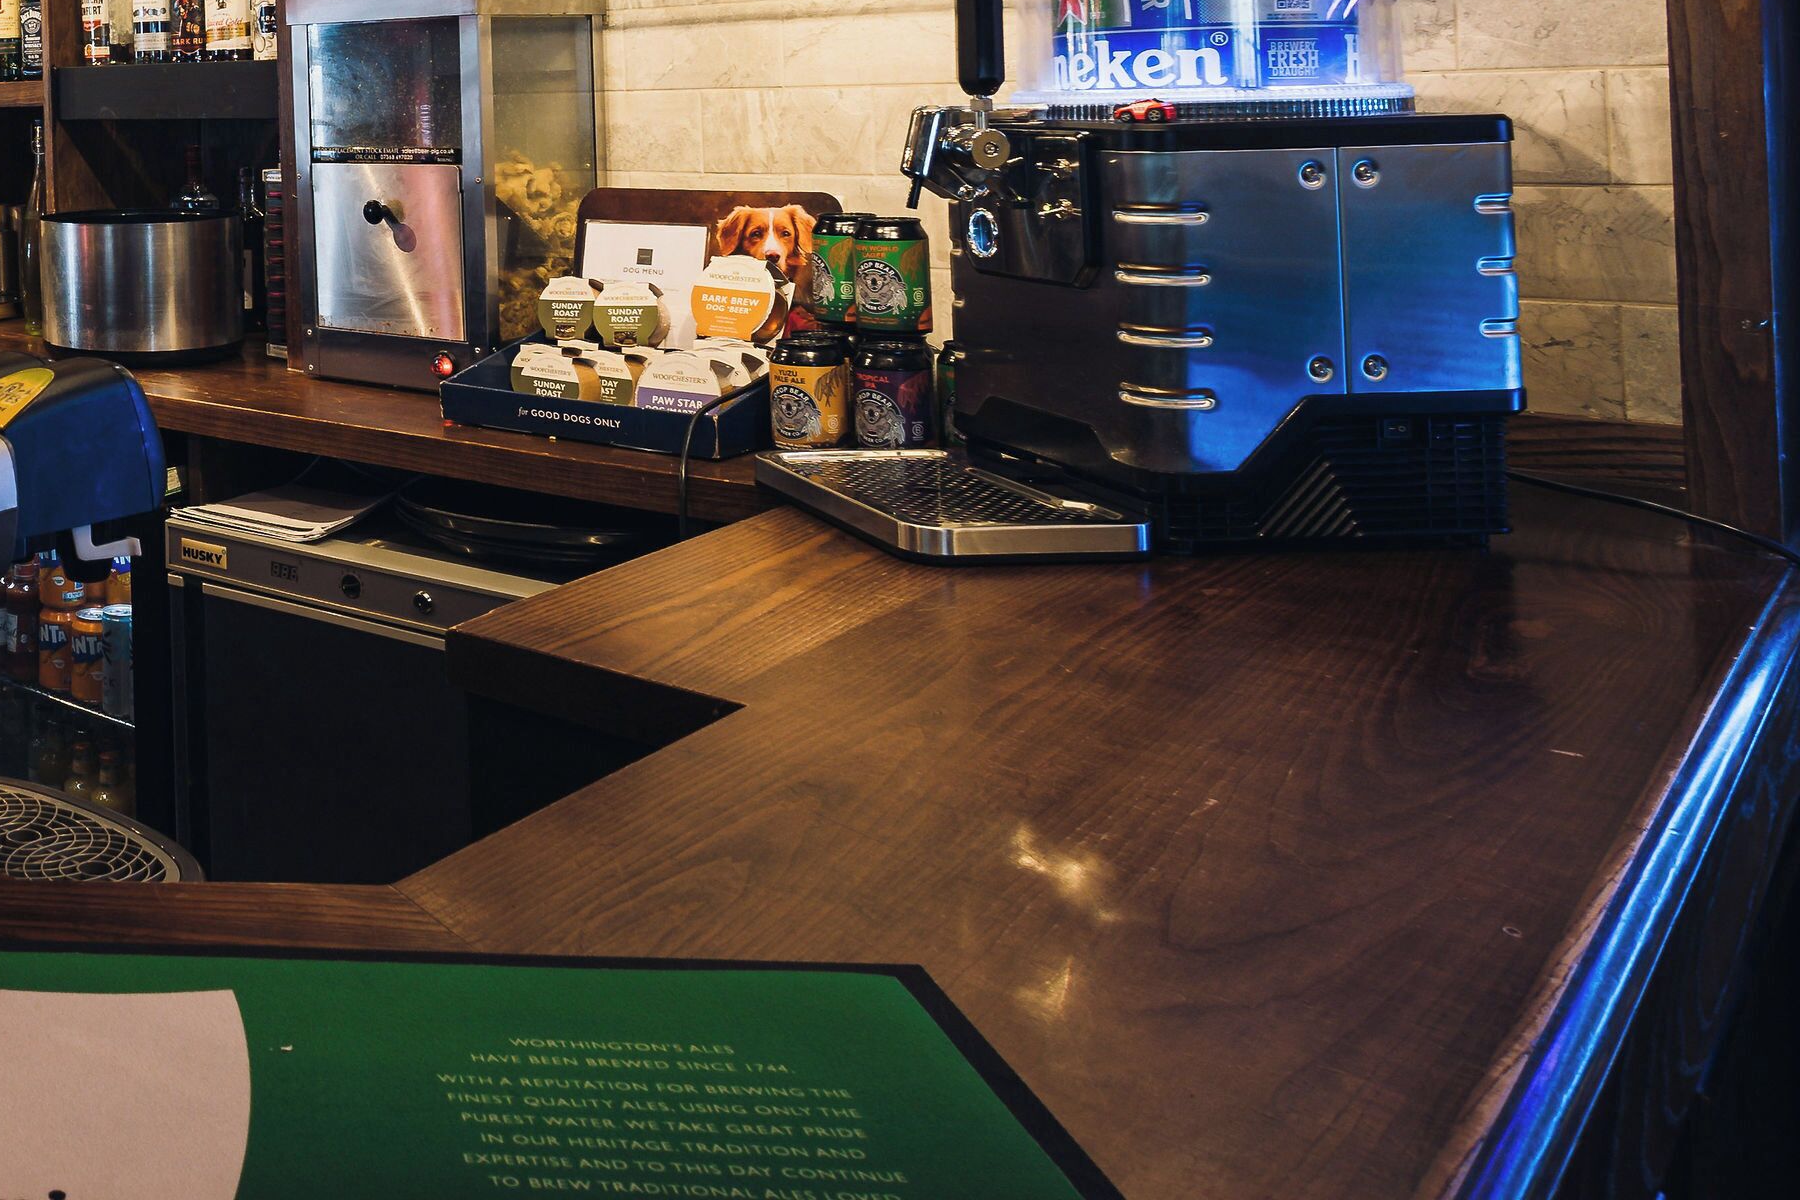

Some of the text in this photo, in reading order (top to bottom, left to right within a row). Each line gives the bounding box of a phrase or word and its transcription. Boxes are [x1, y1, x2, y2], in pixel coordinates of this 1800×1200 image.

[1270, 40, 1316, 51] BREWERY
[1053, 39, 1229, 91] neken
[1268, 50, 1319, 69] FRESH
[1271, 67, 1317, 79] DRAUGHT
[642, 268, 664, 276] MENU
[874, 261, 895, 278] BEAR
[552, 302, 583, 310] SUNDAY
[702, 294, 760, 307] BARK BREW
[705, 304, 725, 312] DOG
[607, 308, 644, 317] SUNDAY
[611, 315, 640, 323] ROAST
[530, 366, 571, 377] WOOFCHESTER'S
[652, 373, 709, 385] WOOFCHESTER'S
[774, 375, 806, 385] PALE ALE
[778, 369, 798, 377] YUZU
[533, 379, 566, 391] SUNDAY
[536, 388, 562, 398] ROAST
[652, 395, 703, 409] PAW STAR
[789, 387, 810, 404] BEAR
[871, 392, 892, 409] BEAR
[518, 406, 621, 429] for GOOD DOGS ONLY
[183, 547, 222, 564] HUSKY
[40, 624, 67, 643] NTA
[509, 1037, 735, 1055] WORTHINGTON'S ALES
[471, 1054, 521, 1065] HAVE
[529, 1055, 578, 1066] BEEN
[585, 1057, 670, 1070] BREWED
[676, 1061, 736, 1072] SINCE
[437, 1073, 853, 1099] WITH A REPUTATION FOR BREWING THE
[448, 1093, 515, 1105] FINEST
[524, 1096, 613, 1109] QUALITY
[680, 1104, 748, 1115] USING
[754, 1105, 811, 1117] ONLY
[819, 1107, 863, 1119] THE
[461, 1112, 535, 1125] PUREST
[625, 1119, 660, 1130] WE
[667, 1122, 719, 1133] TAKE
[726, 1124, 794, 1136] GREAT
[802, 1126, 868, 1139] PRIDE
[480, 1133, 504, 1144] IN
[513, 1134, 560, 1146] OUR
[683, 1142, 809, 1158] TRADITION
[817, 1148, 867, 1160] AND
[464, 1153, 909, 1184] EXPERTISE AND TO THIS DAY CONTINUE
[488, 1175, 520, 1188] TO
[529, 1177, 590, 1191] BREW
[597, 1179, 758, 1199] TRADITIONAL
[764, 1188, 815, 1200] ALES
